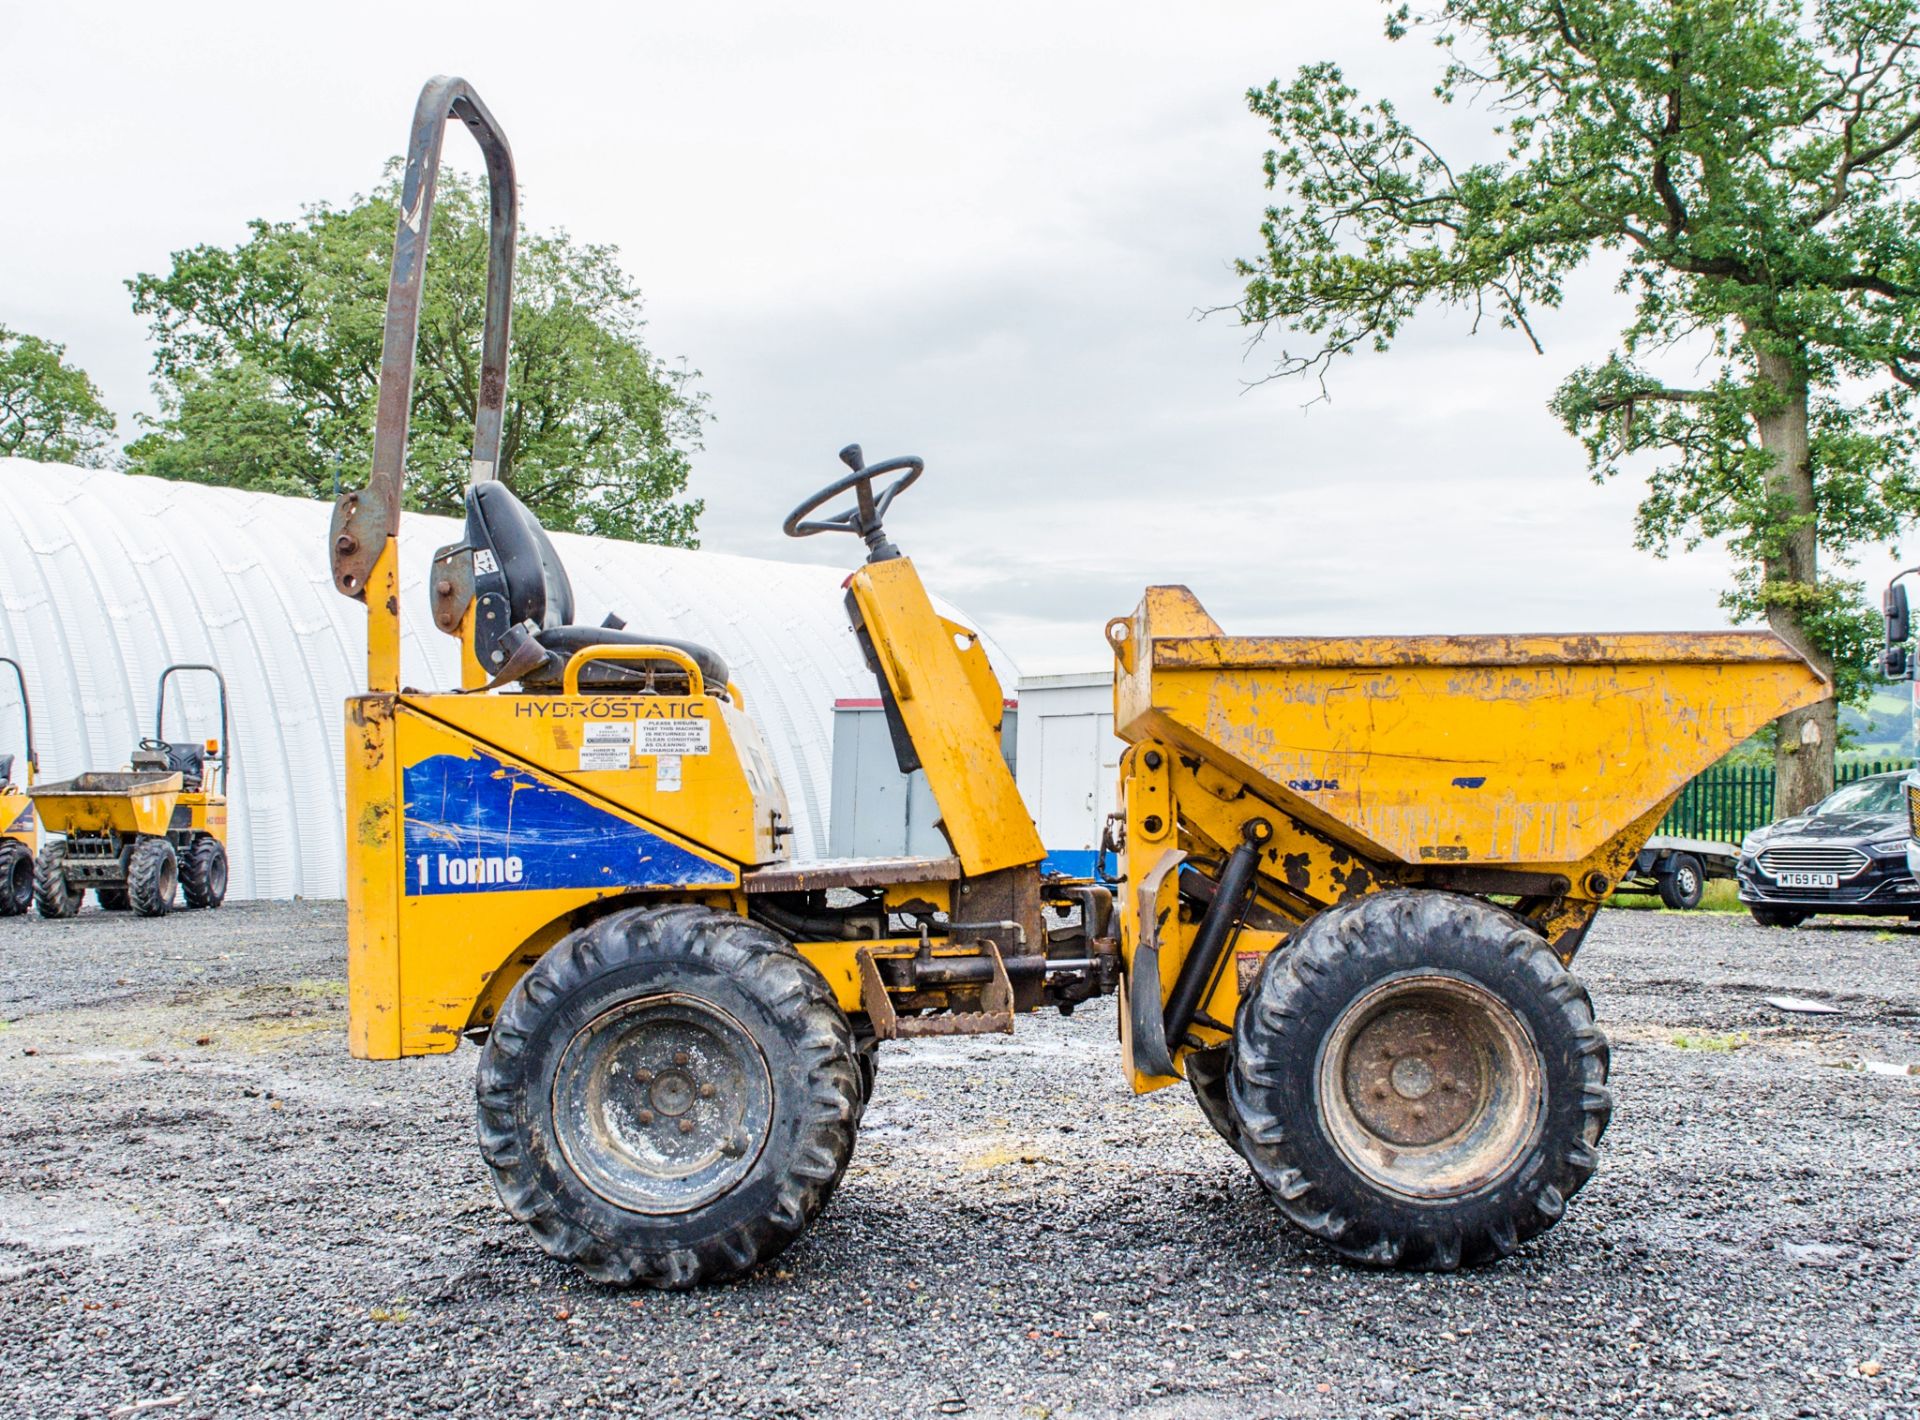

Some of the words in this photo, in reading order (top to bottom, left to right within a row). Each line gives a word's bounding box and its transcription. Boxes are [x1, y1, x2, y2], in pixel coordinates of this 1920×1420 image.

[515, 702, 704, 718] HYDROSTATIC
[417, 854, 429, 886] 1
[438, 853, 523, 885] tonne
[1781, 874, 1809, 885] MT69
[1811, 874, 1834, 886] FLD
